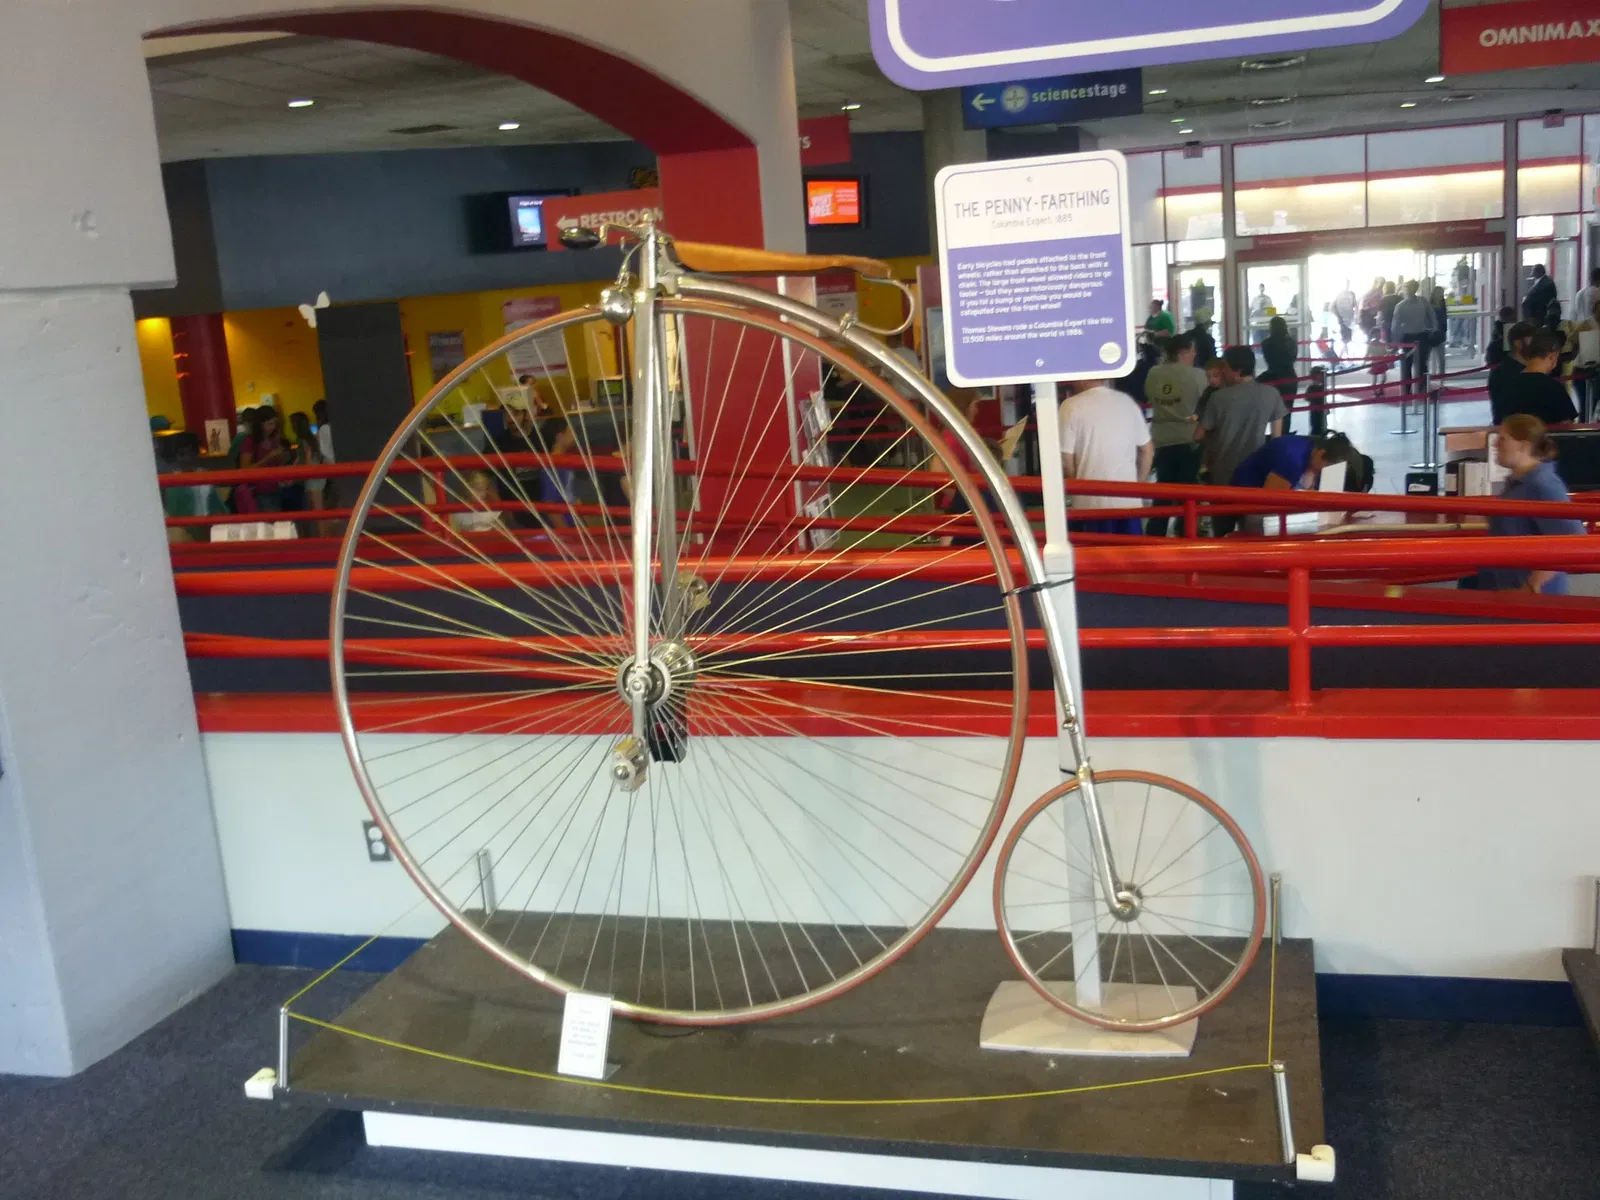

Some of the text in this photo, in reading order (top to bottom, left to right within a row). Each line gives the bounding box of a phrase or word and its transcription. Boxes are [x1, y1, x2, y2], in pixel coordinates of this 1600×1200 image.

[1479, 20, 1600, 47] OMNIMAX
[1031, 83, 1127, 103] sciencestage
[954, 201, 980, 219] THE
